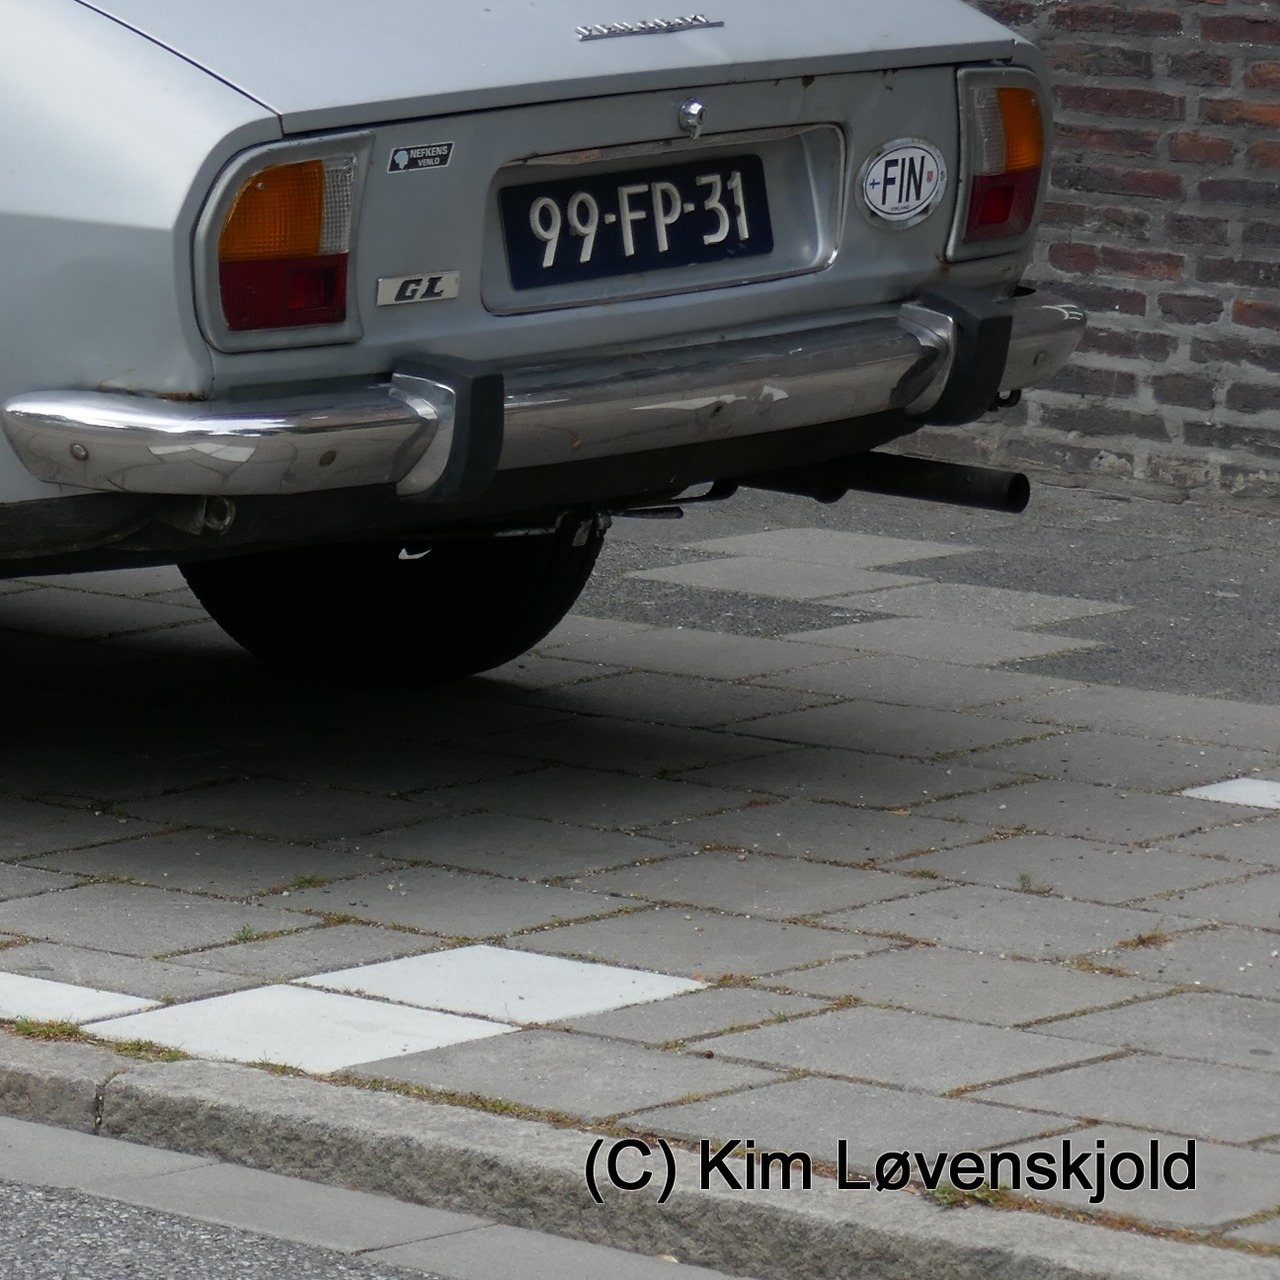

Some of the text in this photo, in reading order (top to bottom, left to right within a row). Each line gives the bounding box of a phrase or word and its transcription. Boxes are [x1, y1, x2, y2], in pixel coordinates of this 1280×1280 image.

[410, 146, 448, 158] NEFKENS
[418, 158, 440, 166] VENLO
[882, 156, 926, 206] FIN
[530, 171, 749, 268] 99-FP-31
[394, 276, 445, 302] GL
